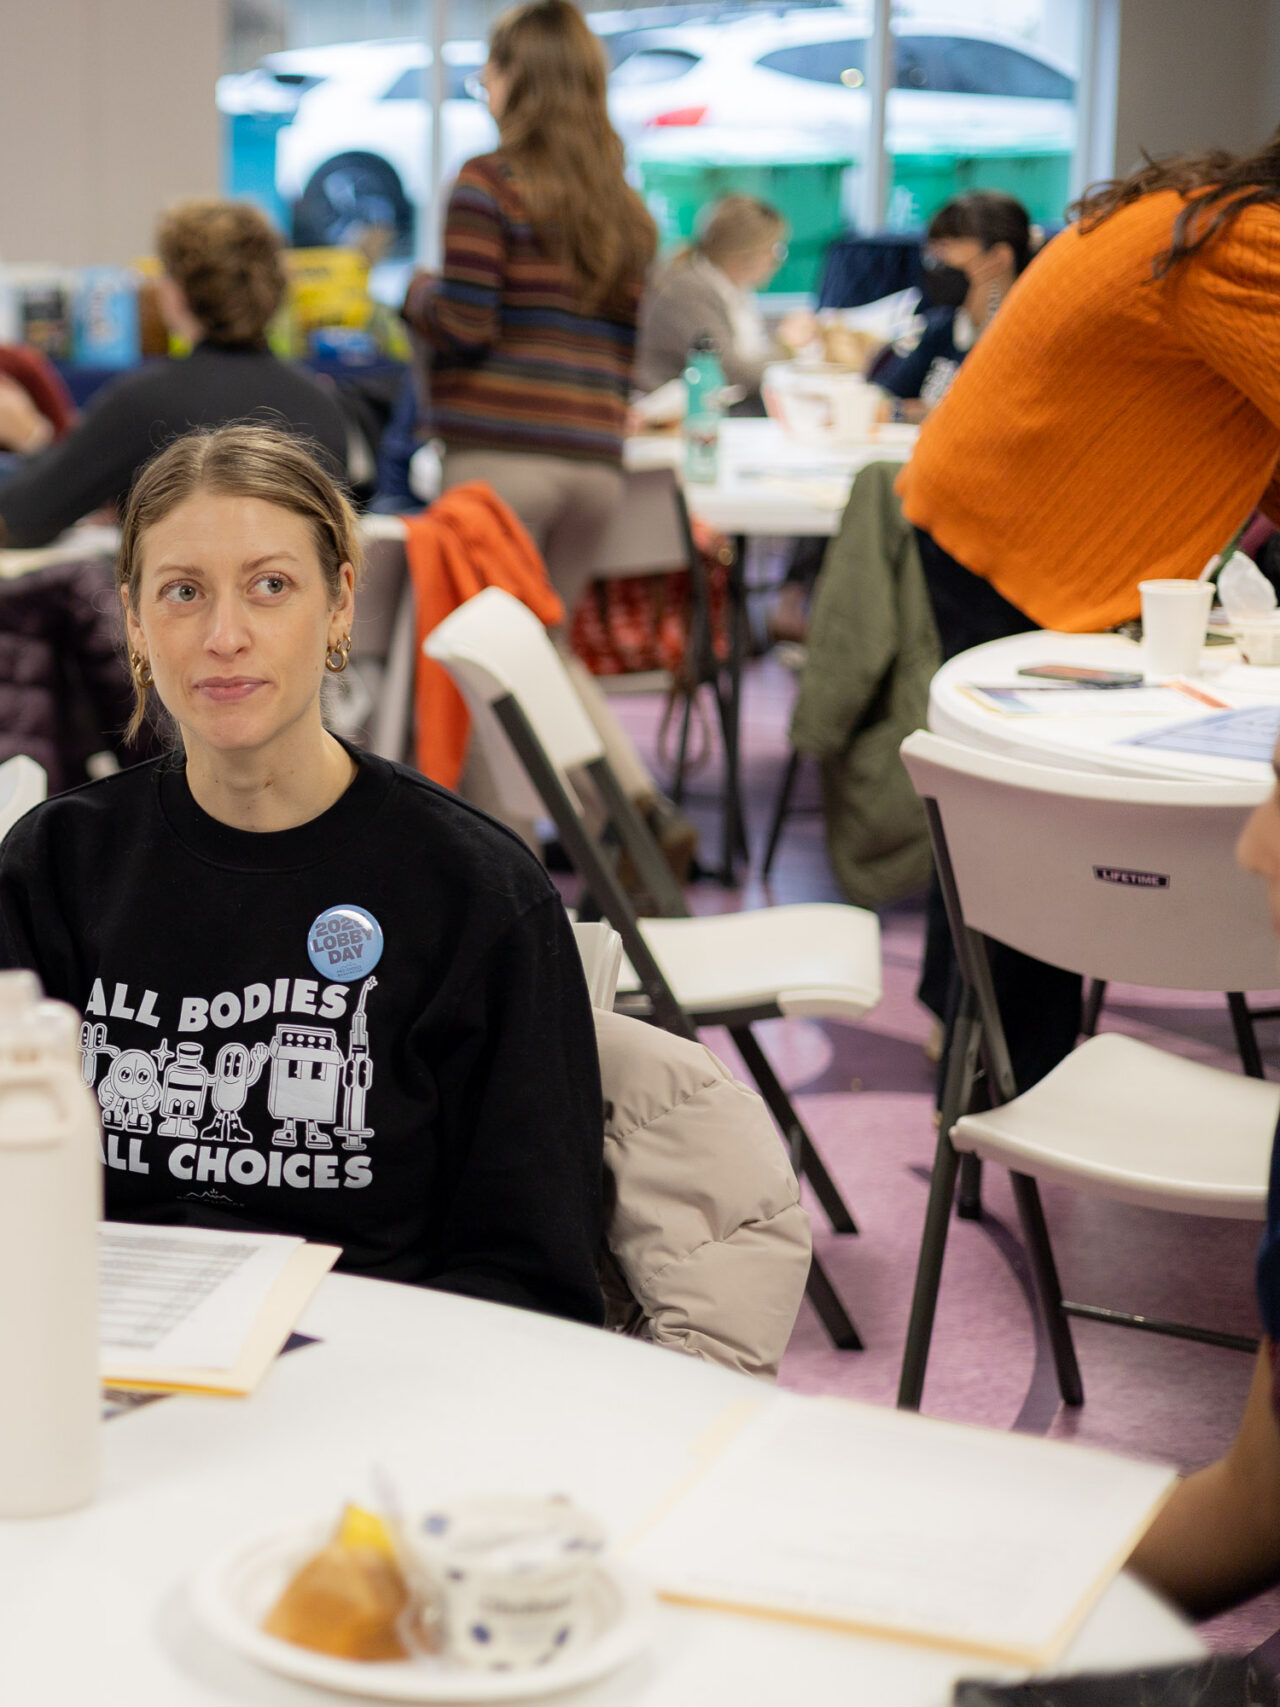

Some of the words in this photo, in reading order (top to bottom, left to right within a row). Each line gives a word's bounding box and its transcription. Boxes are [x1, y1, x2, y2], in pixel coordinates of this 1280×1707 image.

[1103, 869, 1158, 886] LIFETIME
[312, 928, 373, 953] LOBBY
[328, 944, 363, 965] DAY
[85, 977, 161, 1028] ALL
[177, 978, 350, 1032] BODIES
[100, 1134, 150, 1175] LL
[168, 1143, 373, 1189] CHOICES
